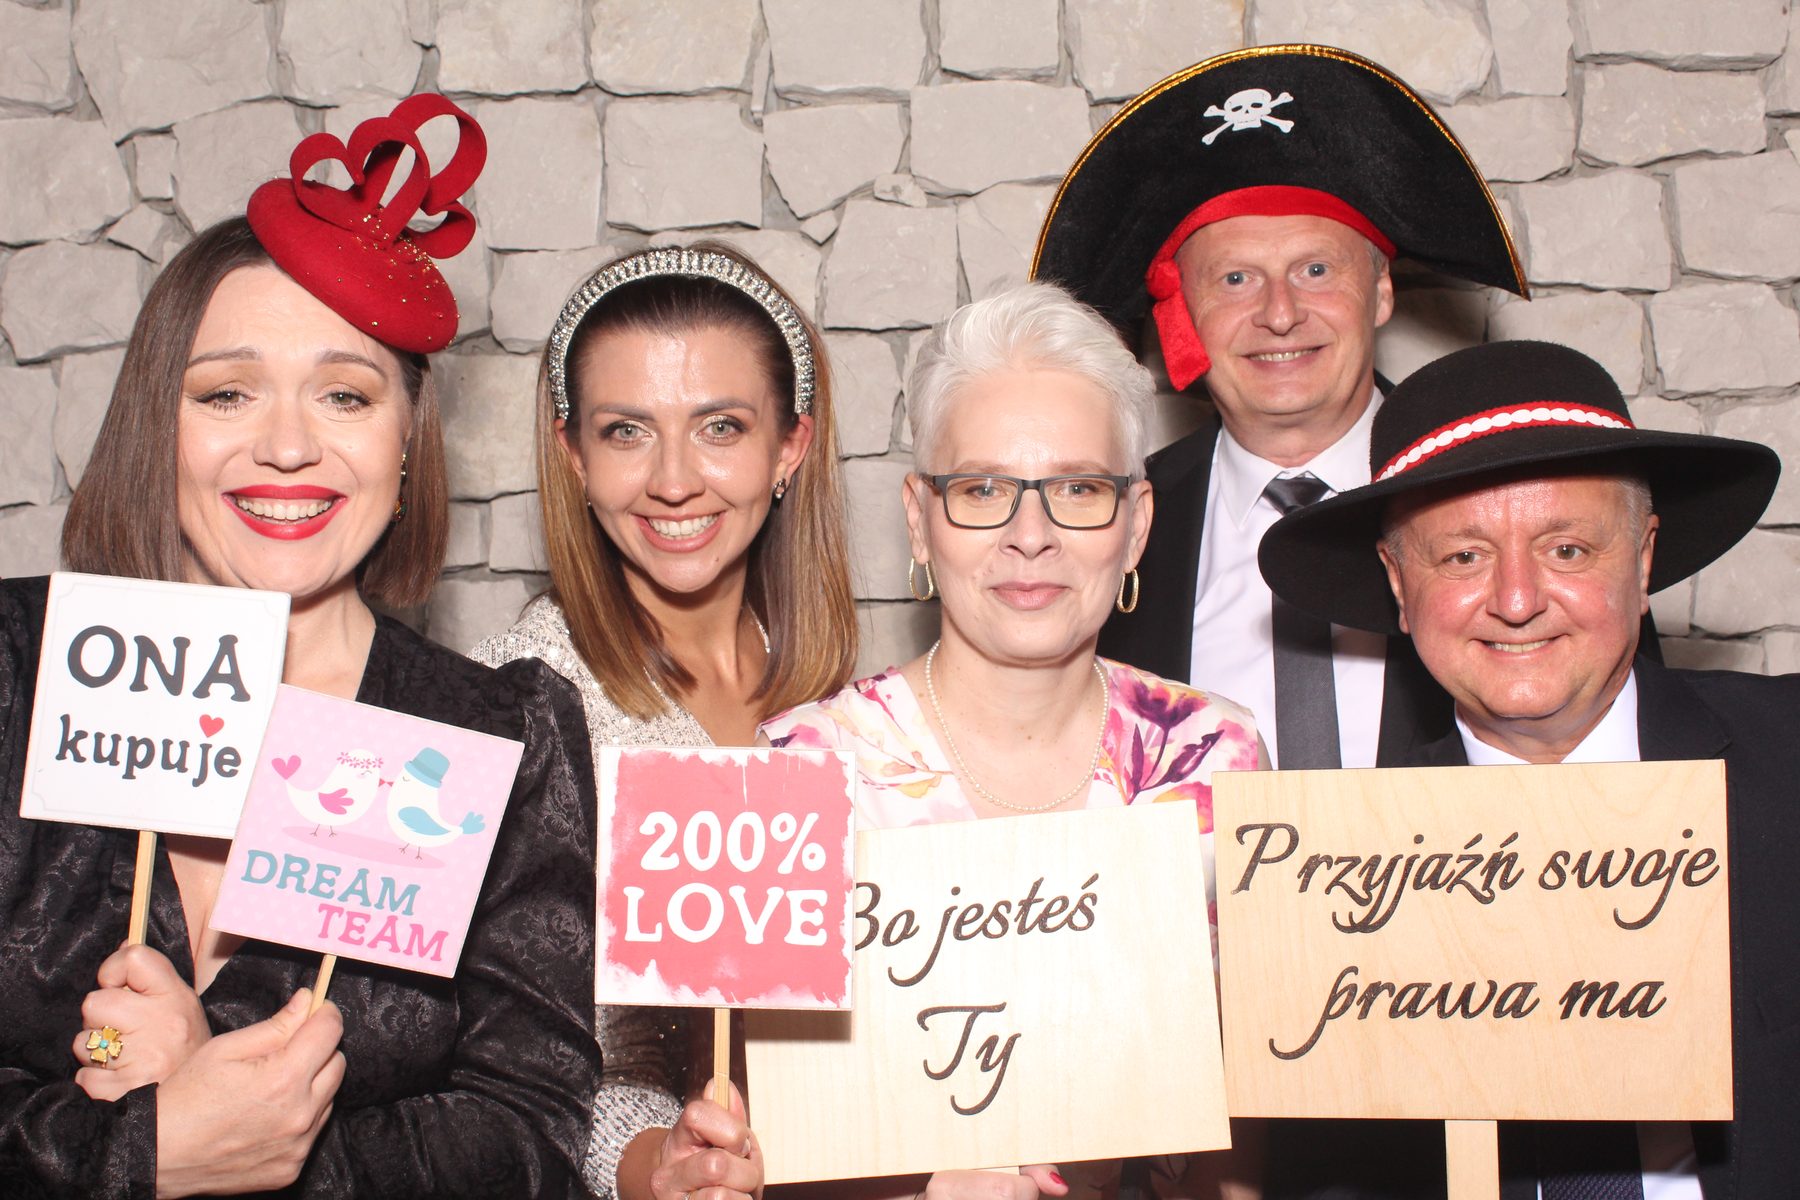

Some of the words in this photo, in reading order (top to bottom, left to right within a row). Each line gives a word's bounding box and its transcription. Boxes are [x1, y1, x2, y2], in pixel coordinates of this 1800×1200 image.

[67, 625, 251, 702] ONA
[55, 713, 242, 788] kupuje
[638, 810, 827, 874] 200%
[1230, 822, 1525, 933] Przyjaźń
[1537, 828, 1721, 930] swoje
[240, 849, 421, 916] DREAM
[623, 883, 828, 946] LOVE
[317, 903, 449, 962] TEAM
[888, 873, 1099, 987] jesteś
[1268, 965, 1540, 1060] prawa
[1558, 978, 1667, 1020] ma
[916, 1002, 1022, 1116] Ty
